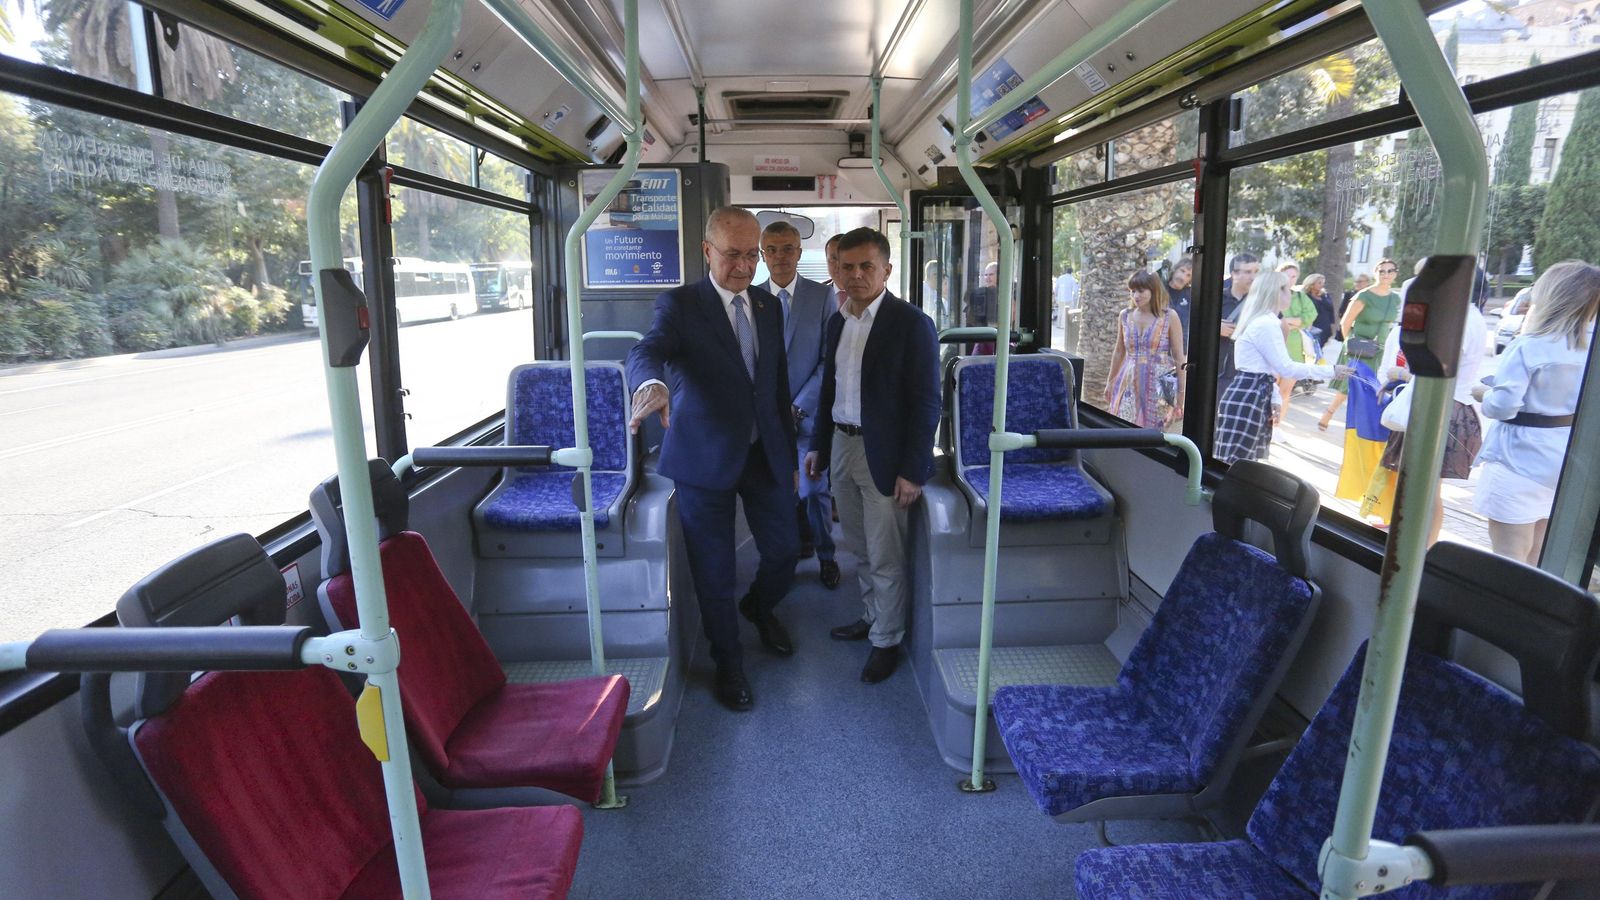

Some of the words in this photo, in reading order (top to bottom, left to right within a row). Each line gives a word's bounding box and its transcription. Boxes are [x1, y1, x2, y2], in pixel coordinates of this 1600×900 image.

[641, 178, 671, 190] EMT
[632, 194, 677, 204] Transporte
[642, 203, 677, 213] Calidad
[632, 214, 649, 222] para
[650, 213, 677, 222] Málaga
[614, 235, 644, 244] Futuro
[605, 251, 662, 260] movimiento
